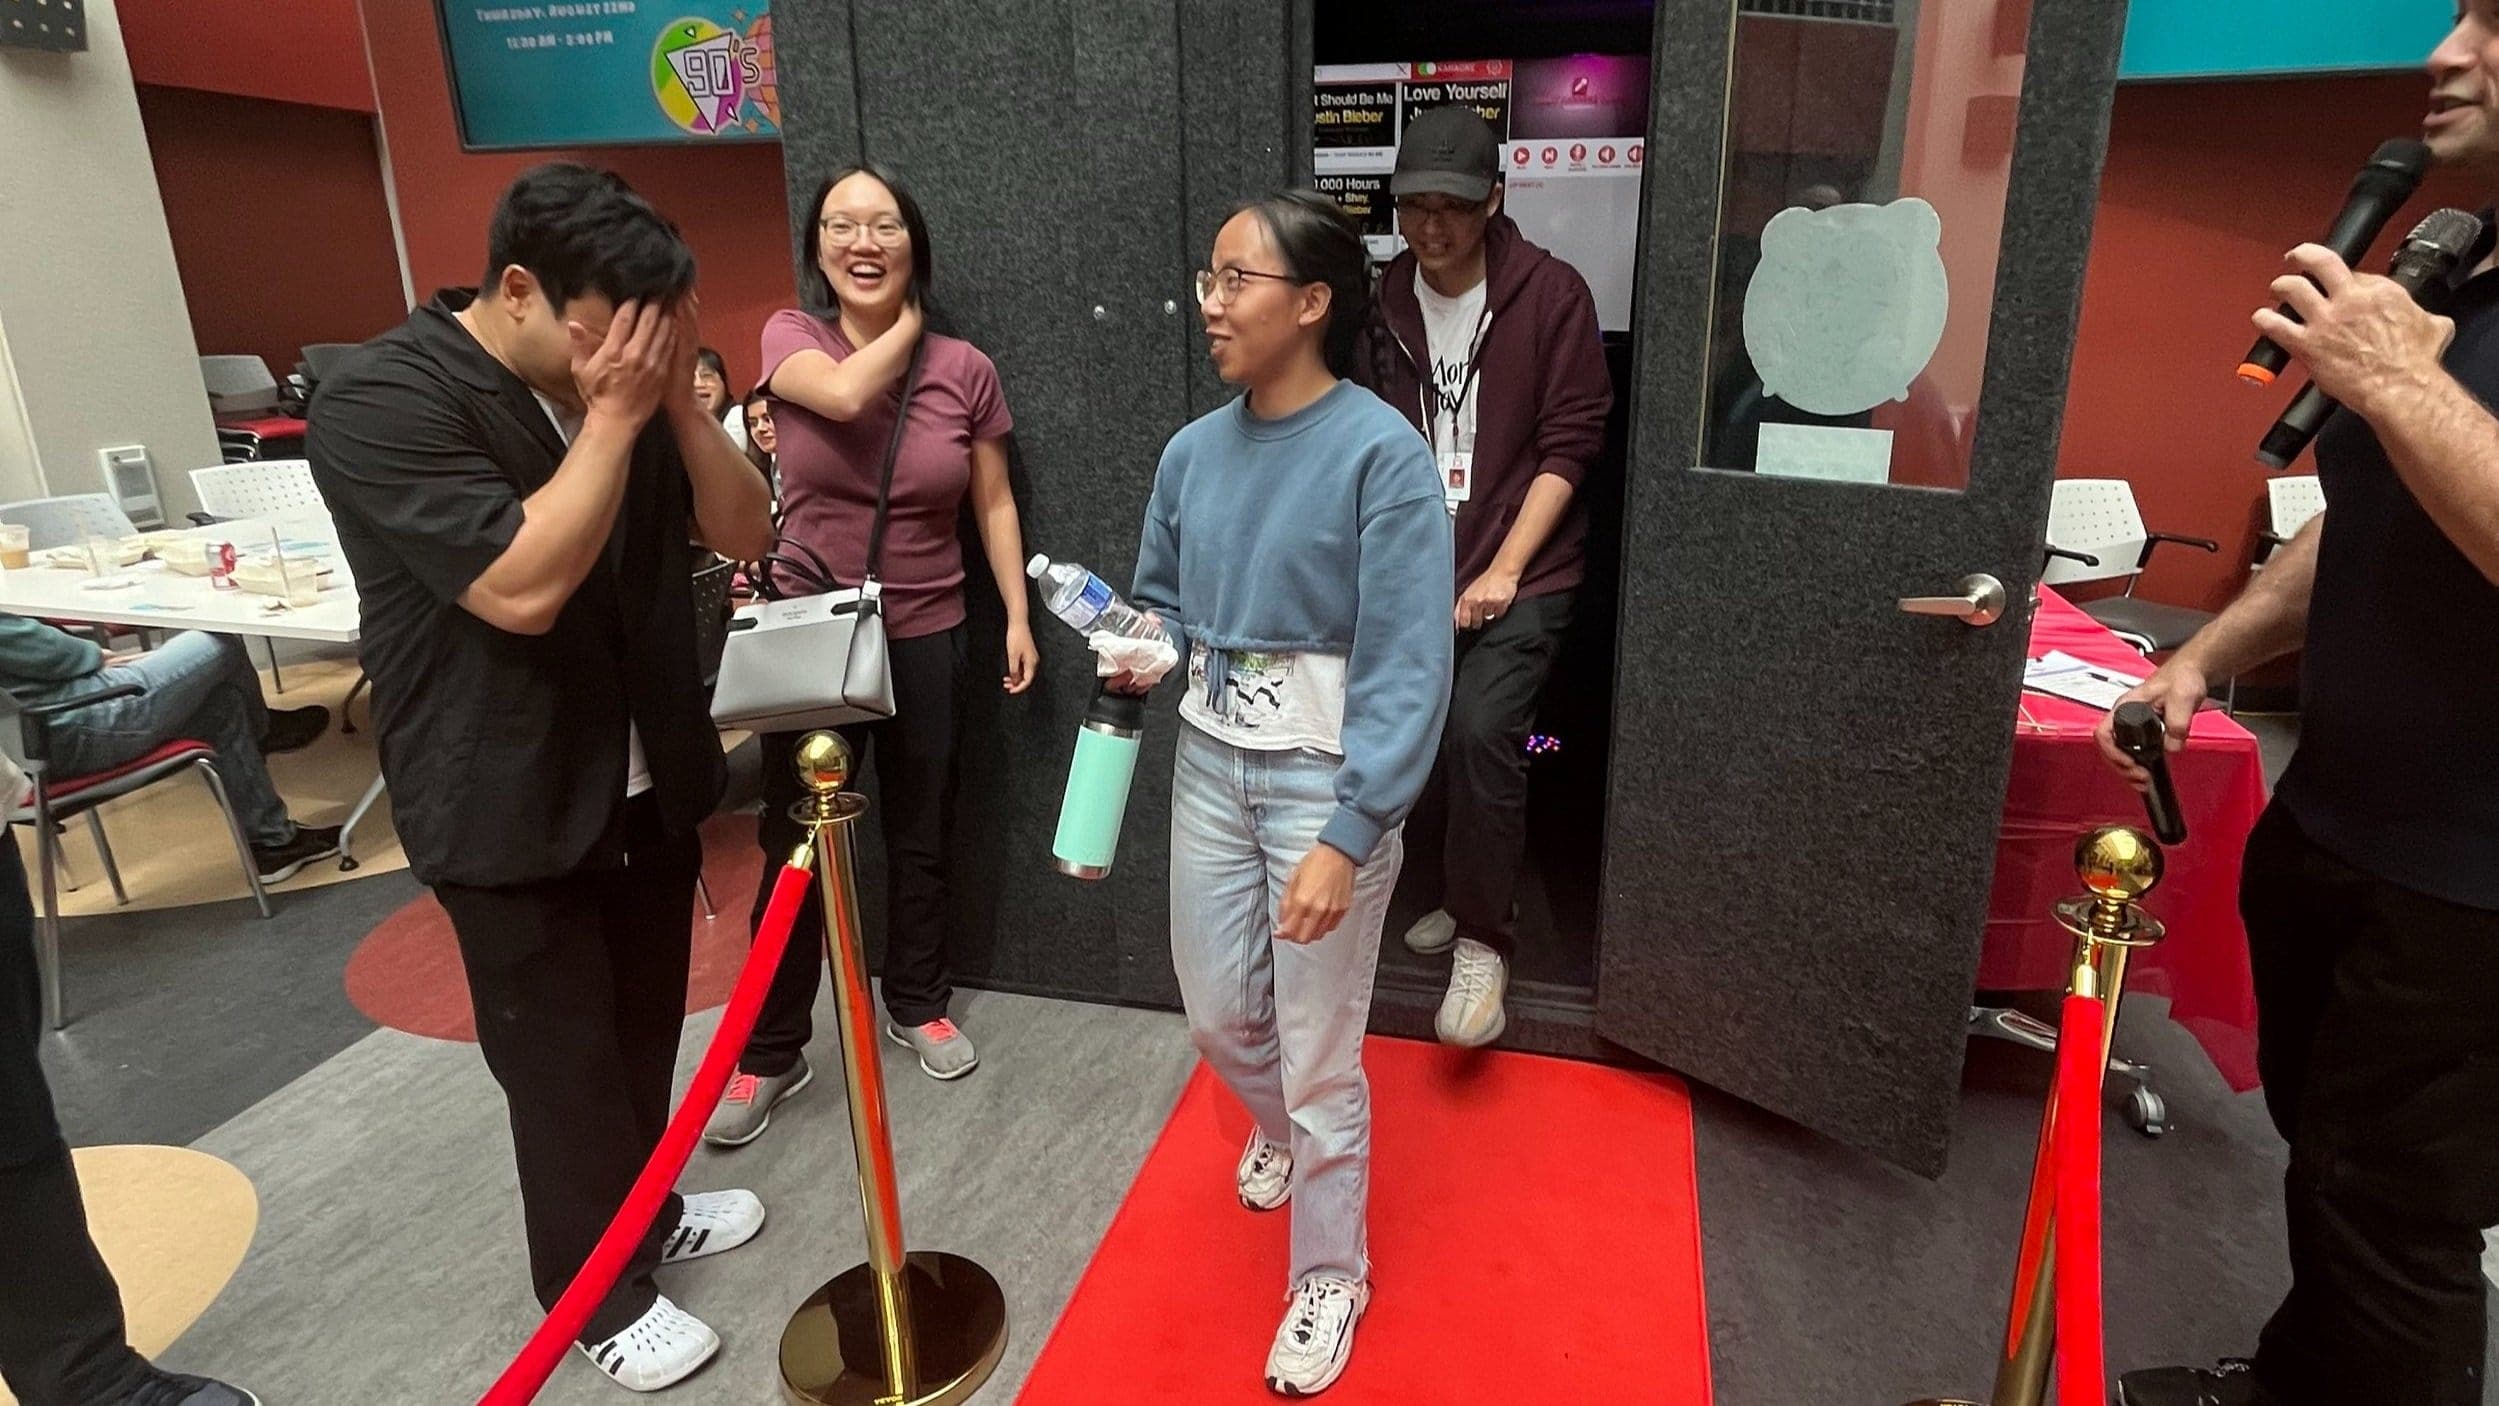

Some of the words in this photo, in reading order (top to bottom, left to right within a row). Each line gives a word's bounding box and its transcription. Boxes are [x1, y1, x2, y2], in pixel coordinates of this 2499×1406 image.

[1320, 92, 1357, 107] Should
[1359, 91, 1375, 106] Be
[1376, 91, 1394, 105] Me
[1403, 85, 1441, 101] Love
[1445, 82, 1507, 100] Yourself
[1342, 109, 1384, 124] Bieber
[1346, 178, 1381, 191] Hours
